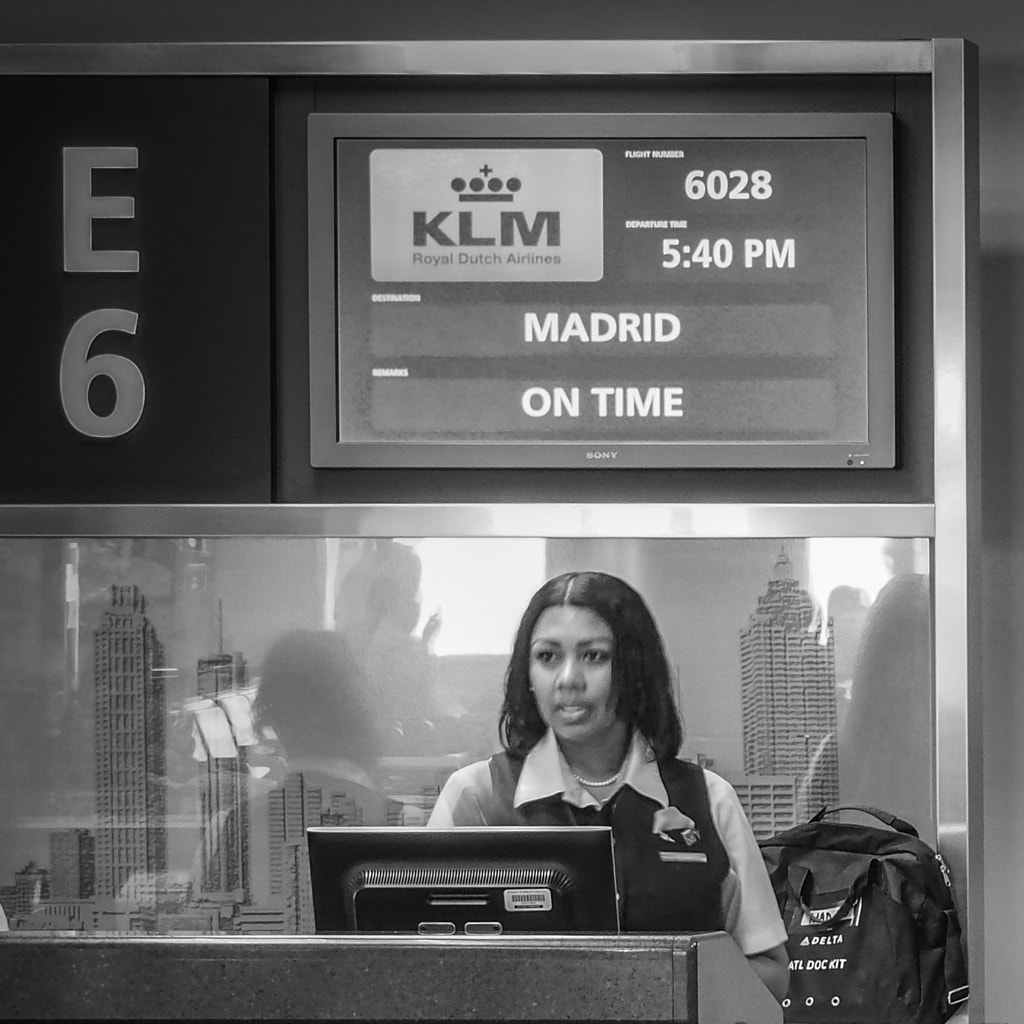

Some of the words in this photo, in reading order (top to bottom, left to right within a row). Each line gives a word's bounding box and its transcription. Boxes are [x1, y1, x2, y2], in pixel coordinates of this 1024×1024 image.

[625, 150, 651, 158] FLIGHT
[652, 150, 685, 158] NUMBER
[684, 169, 773, 200] 6028
[61, 146, 140, 273] E
[412, 211, 561, 247] KLM
[625, 220, 668, 229] DEPARTURE
[669, 220, 688, 229] TIME
[412, 252, 453, 267] Royal
[458, 252, 502, 265] Dutch
[506, 252, 561, 265] Airlines
[662, 238, 733, 269] 5:40
[744, 238, 796, 269] PM
[371, 293, 421, 302] DESTINATION
[524, 312, 681, 343] MADRID
[59, 308, 146, 438] 6
[372, 368, 409, 377] REMARKS
[521, 387, 580, 417] ON
[590, 387, 684, 417] TIME
[811, 934, 843, 946] DELTA
[788, 959, 804, 971] ATL
[806, 959, 828, 970] DOC
[828, 958, 847, 970] KIT
